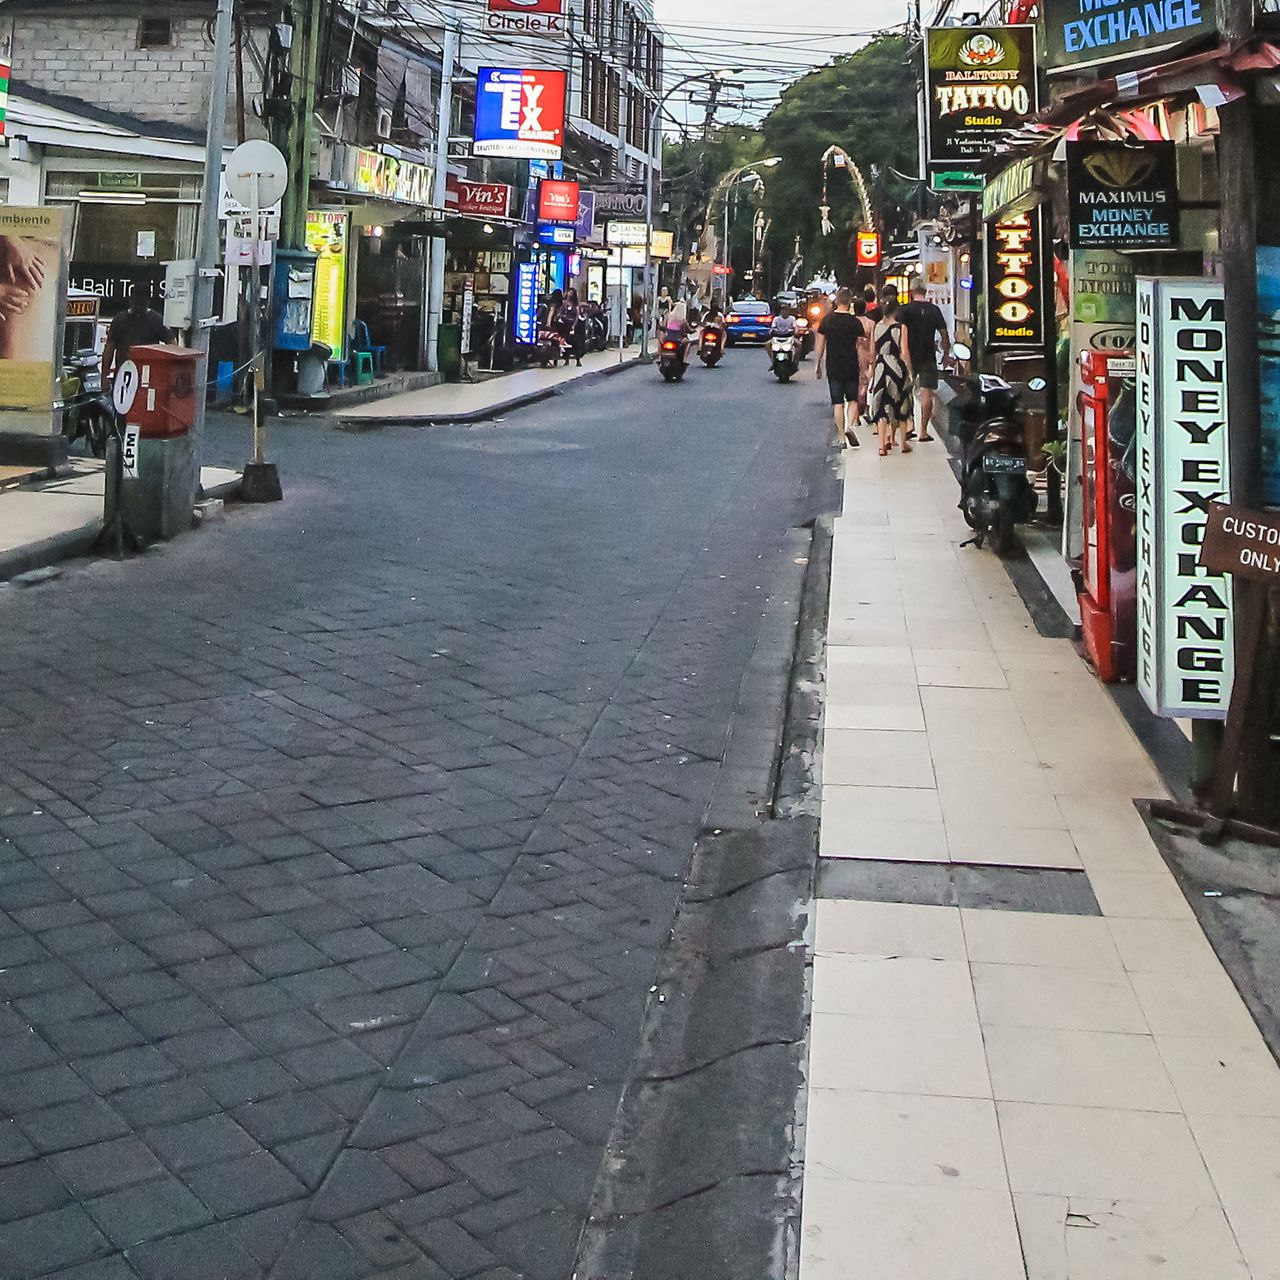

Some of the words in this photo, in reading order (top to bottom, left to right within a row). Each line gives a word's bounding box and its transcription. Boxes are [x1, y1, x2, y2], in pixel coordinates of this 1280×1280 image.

[487, 12, 542, 30] Circle
[547, 16, 561, 31] K
[935, 83, 1030, 120] TATTOO
[964, 115, 1003, 126] Studio
[461, 185, 505, 204] Vin's
[1079, 190, 1167, 204] MAXIMUS
[1092, 208, 1153, 222] MONEY
[1078, 223, 1170, 237] EXCHANGE
[995, 327, 1034, 337] Studio
[1138, 290, 1151, 436] MONEY
[1169, 297, 1227, 444] MONEY
[1139, 446, 1153, 689] EXCHANGE
